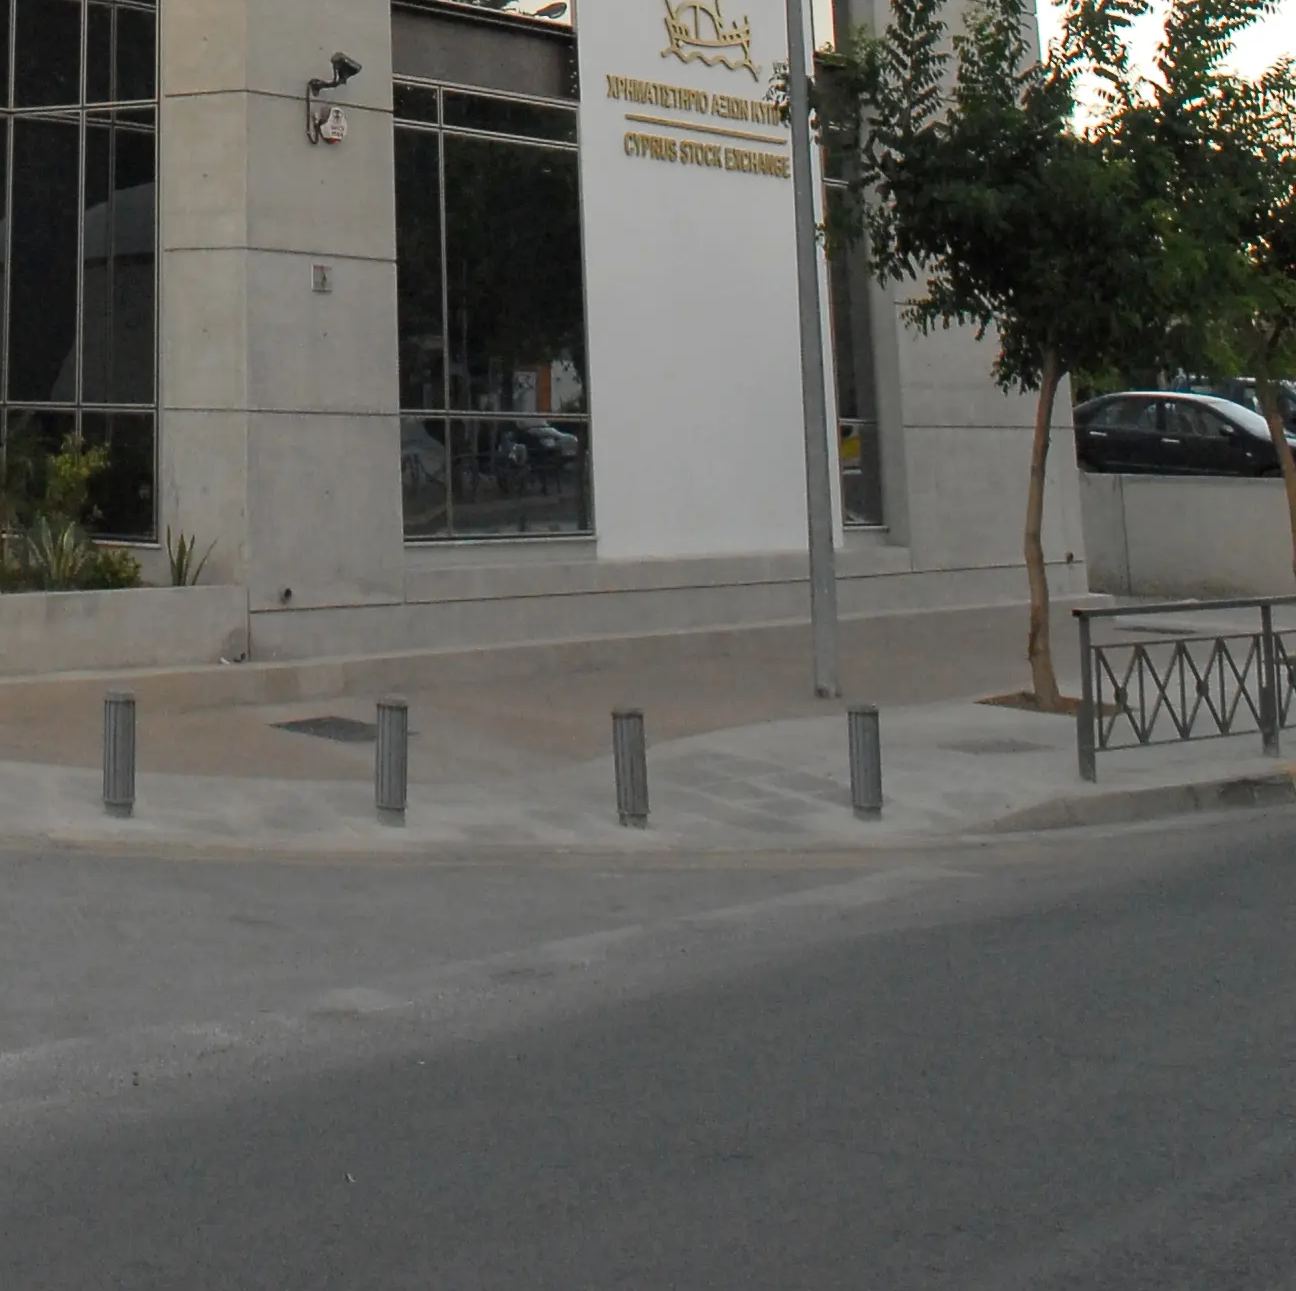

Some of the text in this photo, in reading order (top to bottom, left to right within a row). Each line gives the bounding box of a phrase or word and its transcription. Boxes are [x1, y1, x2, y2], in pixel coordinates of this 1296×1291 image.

[624, 132, 791, 179] CYPRUS STOCK EXCHANGE
